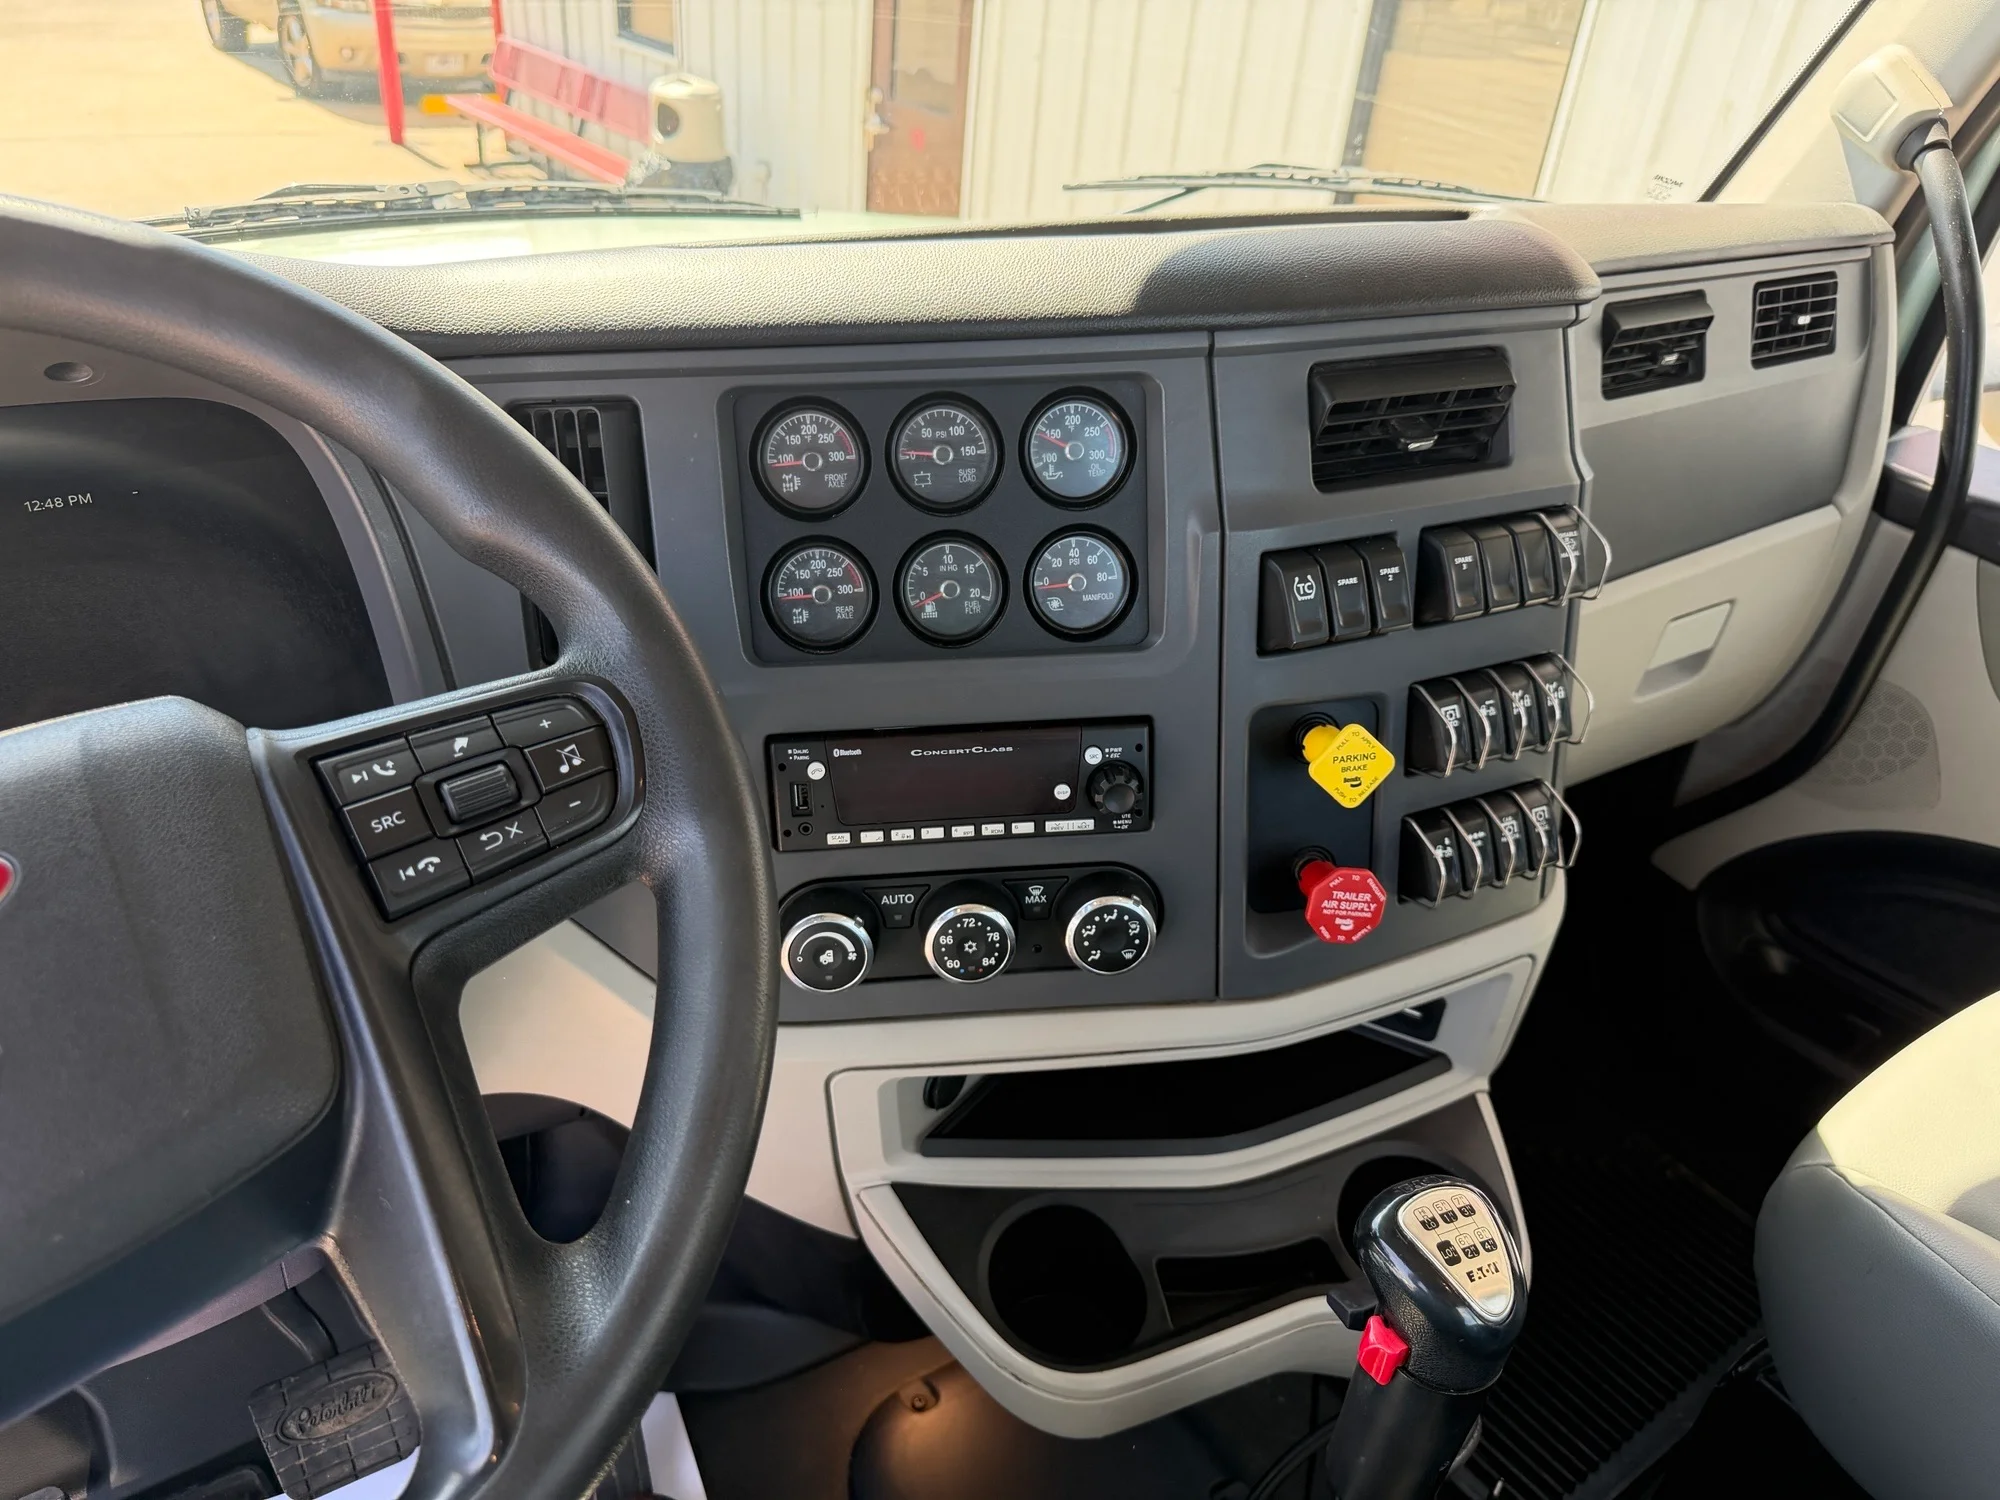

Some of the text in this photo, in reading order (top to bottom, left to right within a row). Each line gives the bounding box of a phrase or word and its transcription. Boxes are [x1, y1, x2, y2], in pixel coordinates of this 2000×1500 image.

[1065, 414, 1081, 425] 200
[801, 424, 817, 435] 200
[921, 426, 965, 438] 50 PSI 100
[1045, 429, 1061, 439] 150
[1084, 426, 1100, 437] 250
[785, 435, 801, 445] 150
[818, 433, 834, 444] 250
[960, 446, 976, 456] 150
[1089, 450, 1105, 460] 300
[778, 454, 794, 463] 100
[828, 451, 845, 462] 300
[1042, 453, 1058, 463] 100
[958, 468, 976, 476] SUSP
[1088, 469, 1106, 477] TEMP
[824, 473, 848, 482] FRONT
[958, 475, 976, 483] LOAD
[828, 480, 845, 488] AXLE
[24, 493, 93, 512] 12:48 PM
[1069, 548, 1080, 558] 40
[943, 554, 954, 564] 10
[1051, 558, 1062, 568] 20
[1069, 558, 1080, 566] PSI
[1087, 555, 1098, 565] 60
[1454, 555, 1473, 565] SPARE
[810, 560, 827, 570] 200
[947, 564, 958, 572] HG
[964, 564, 975, 574] 15
[795, 570, 811, 579] 150
[827, 567, 843, 578] 250
[923, 567, 929, 577] 5
[1379, 566, 1400, 576] SPARE
[1043, 577, 1049, 586] 0
[1096, 572, 1107, 582] 80
[1337, 576, 1358, 586] SPARE
[1388, 574, 1393, 582] 2
[788, 588, 804, 597] 100
[837, 585, 853, 594] 300
[970, 588, 981, 598] 20
[1296, 582, 1313, 595] TC
[920, 591, 926, 601] 0
[1082, 592, 1114, 602] MANIFOLD
[835, 605, 854, 614] REAR
[837, 612, 854, 620] AXLE
[1336, 738, 1350, 751] PULL
[1361, 737, 1376, 749] APPLY
[1332, 752, 1376, 764] PARKING
[1341, 764, 1368, 773] BRAKE
[1358, 776, 1379, 797] RELEASE
[371, 810, 406, 833] SRC
[881, 893, 915, 905] AUTO
[1025, 894, 1047, 904] MAX
[1332, 890, 1372, 902] TRAILER
[1321, 900, 1377, 912] AIR SUPPLY
[1347, 910, 1372, 918] PARKING
[962, 918, 976, 928] 72
[939, 935, 953, 945] 66
[987, 932, 1000, 942] 78
[946, 959, 961, 969] 60
[982, 957, 996, 966] 84
[1454, 1197, 1461, 1205] 7
[1435, 1203, 1443, 1211] 5
[1461, 1207, 1469, 1215] 3
[1476, 1231, 1484, 1239] 8
[1458, 1237, 1465, 1246] 6
